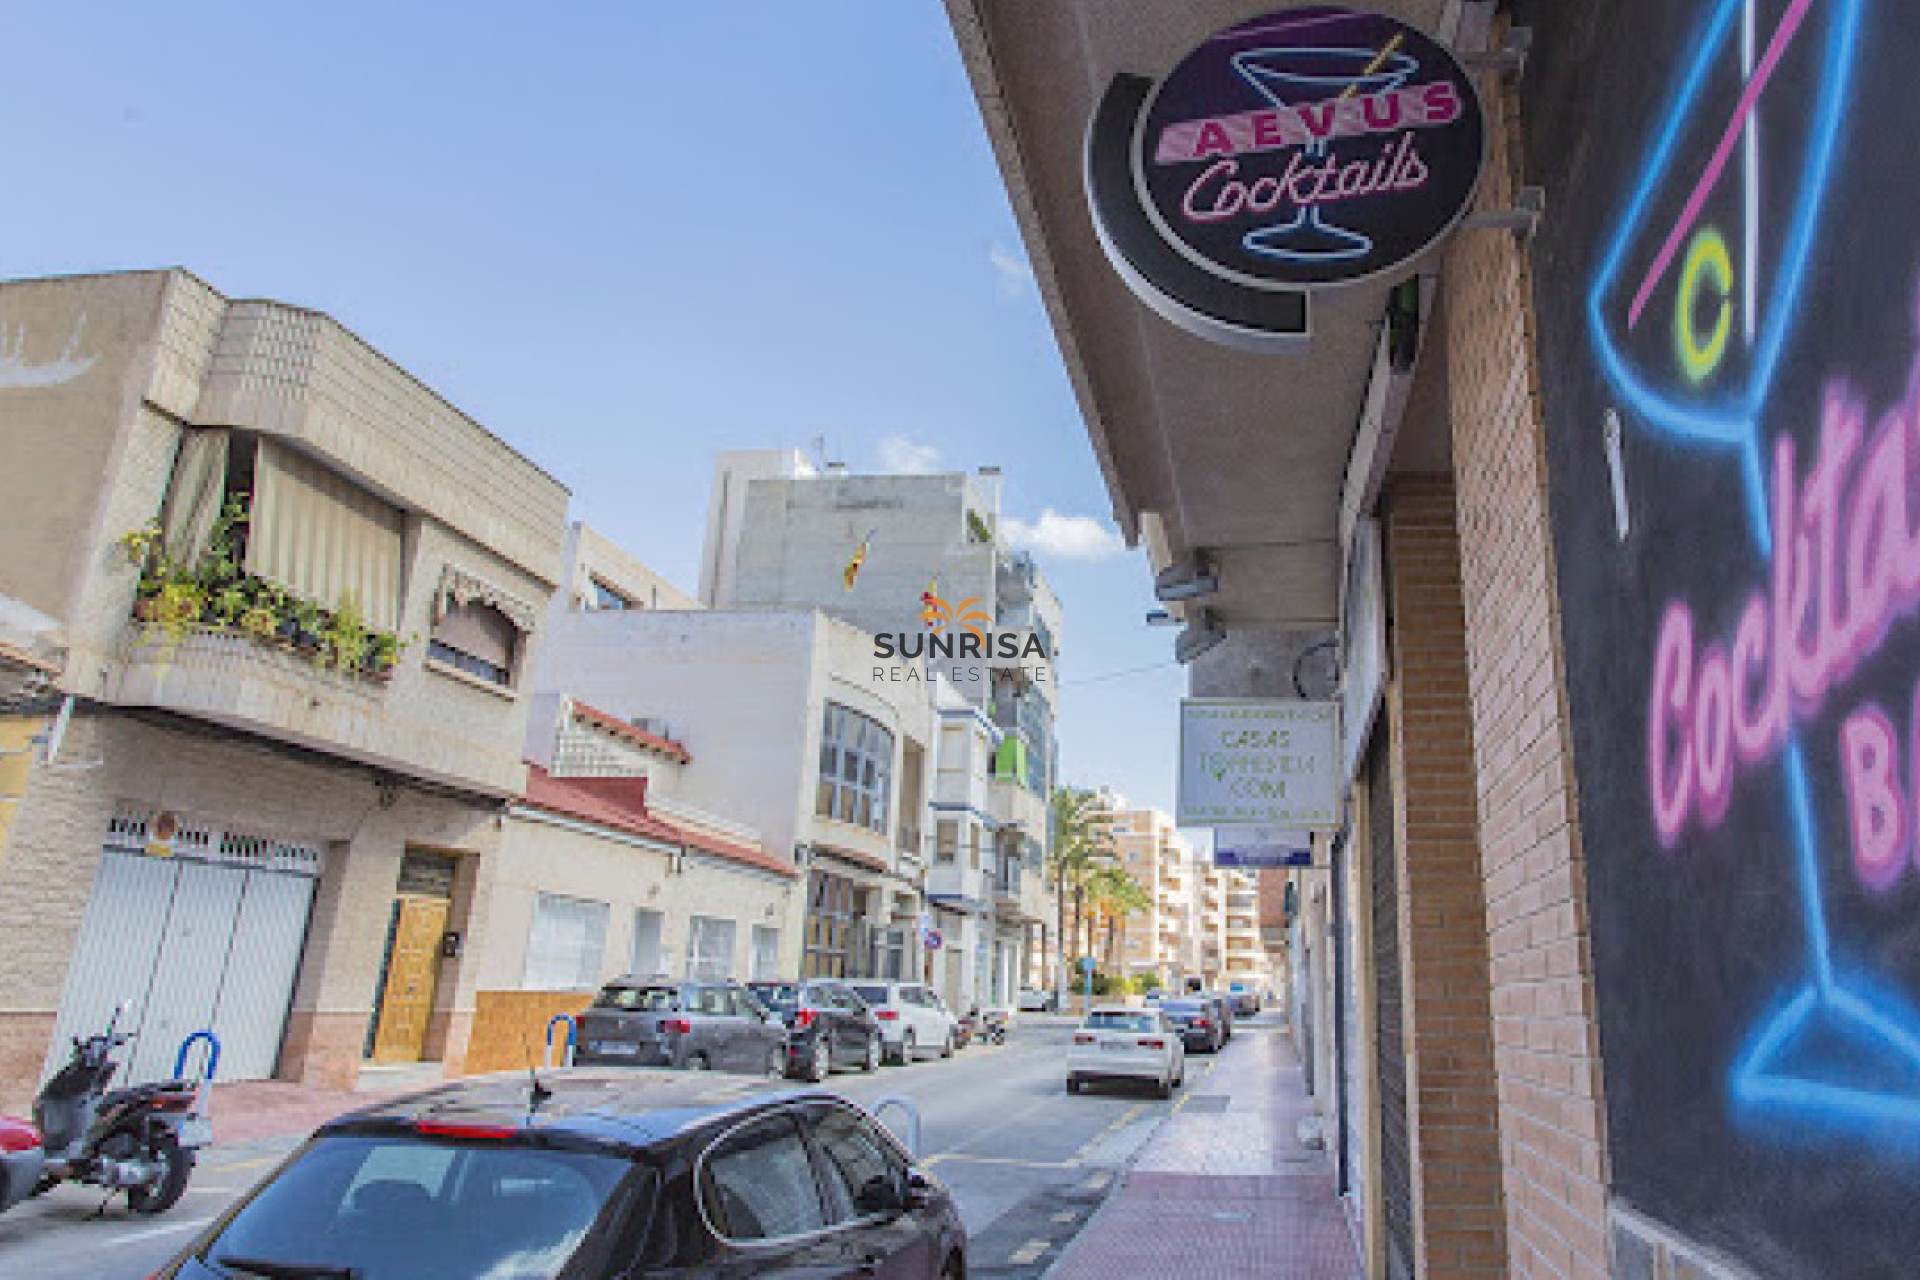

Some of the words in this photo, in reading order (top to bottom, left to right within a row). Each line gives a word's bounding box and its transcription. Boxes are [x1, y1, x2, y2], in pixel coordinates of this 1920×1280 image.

[1194, 85, 1456, 156] AEVUS
[1182, 131, 1428, 221] Cocktails
[1650, 310, 1920, 846] Cockta
[1220, 729, 1291, 749] CASAS
[1840, 680, 1920, 886] B
